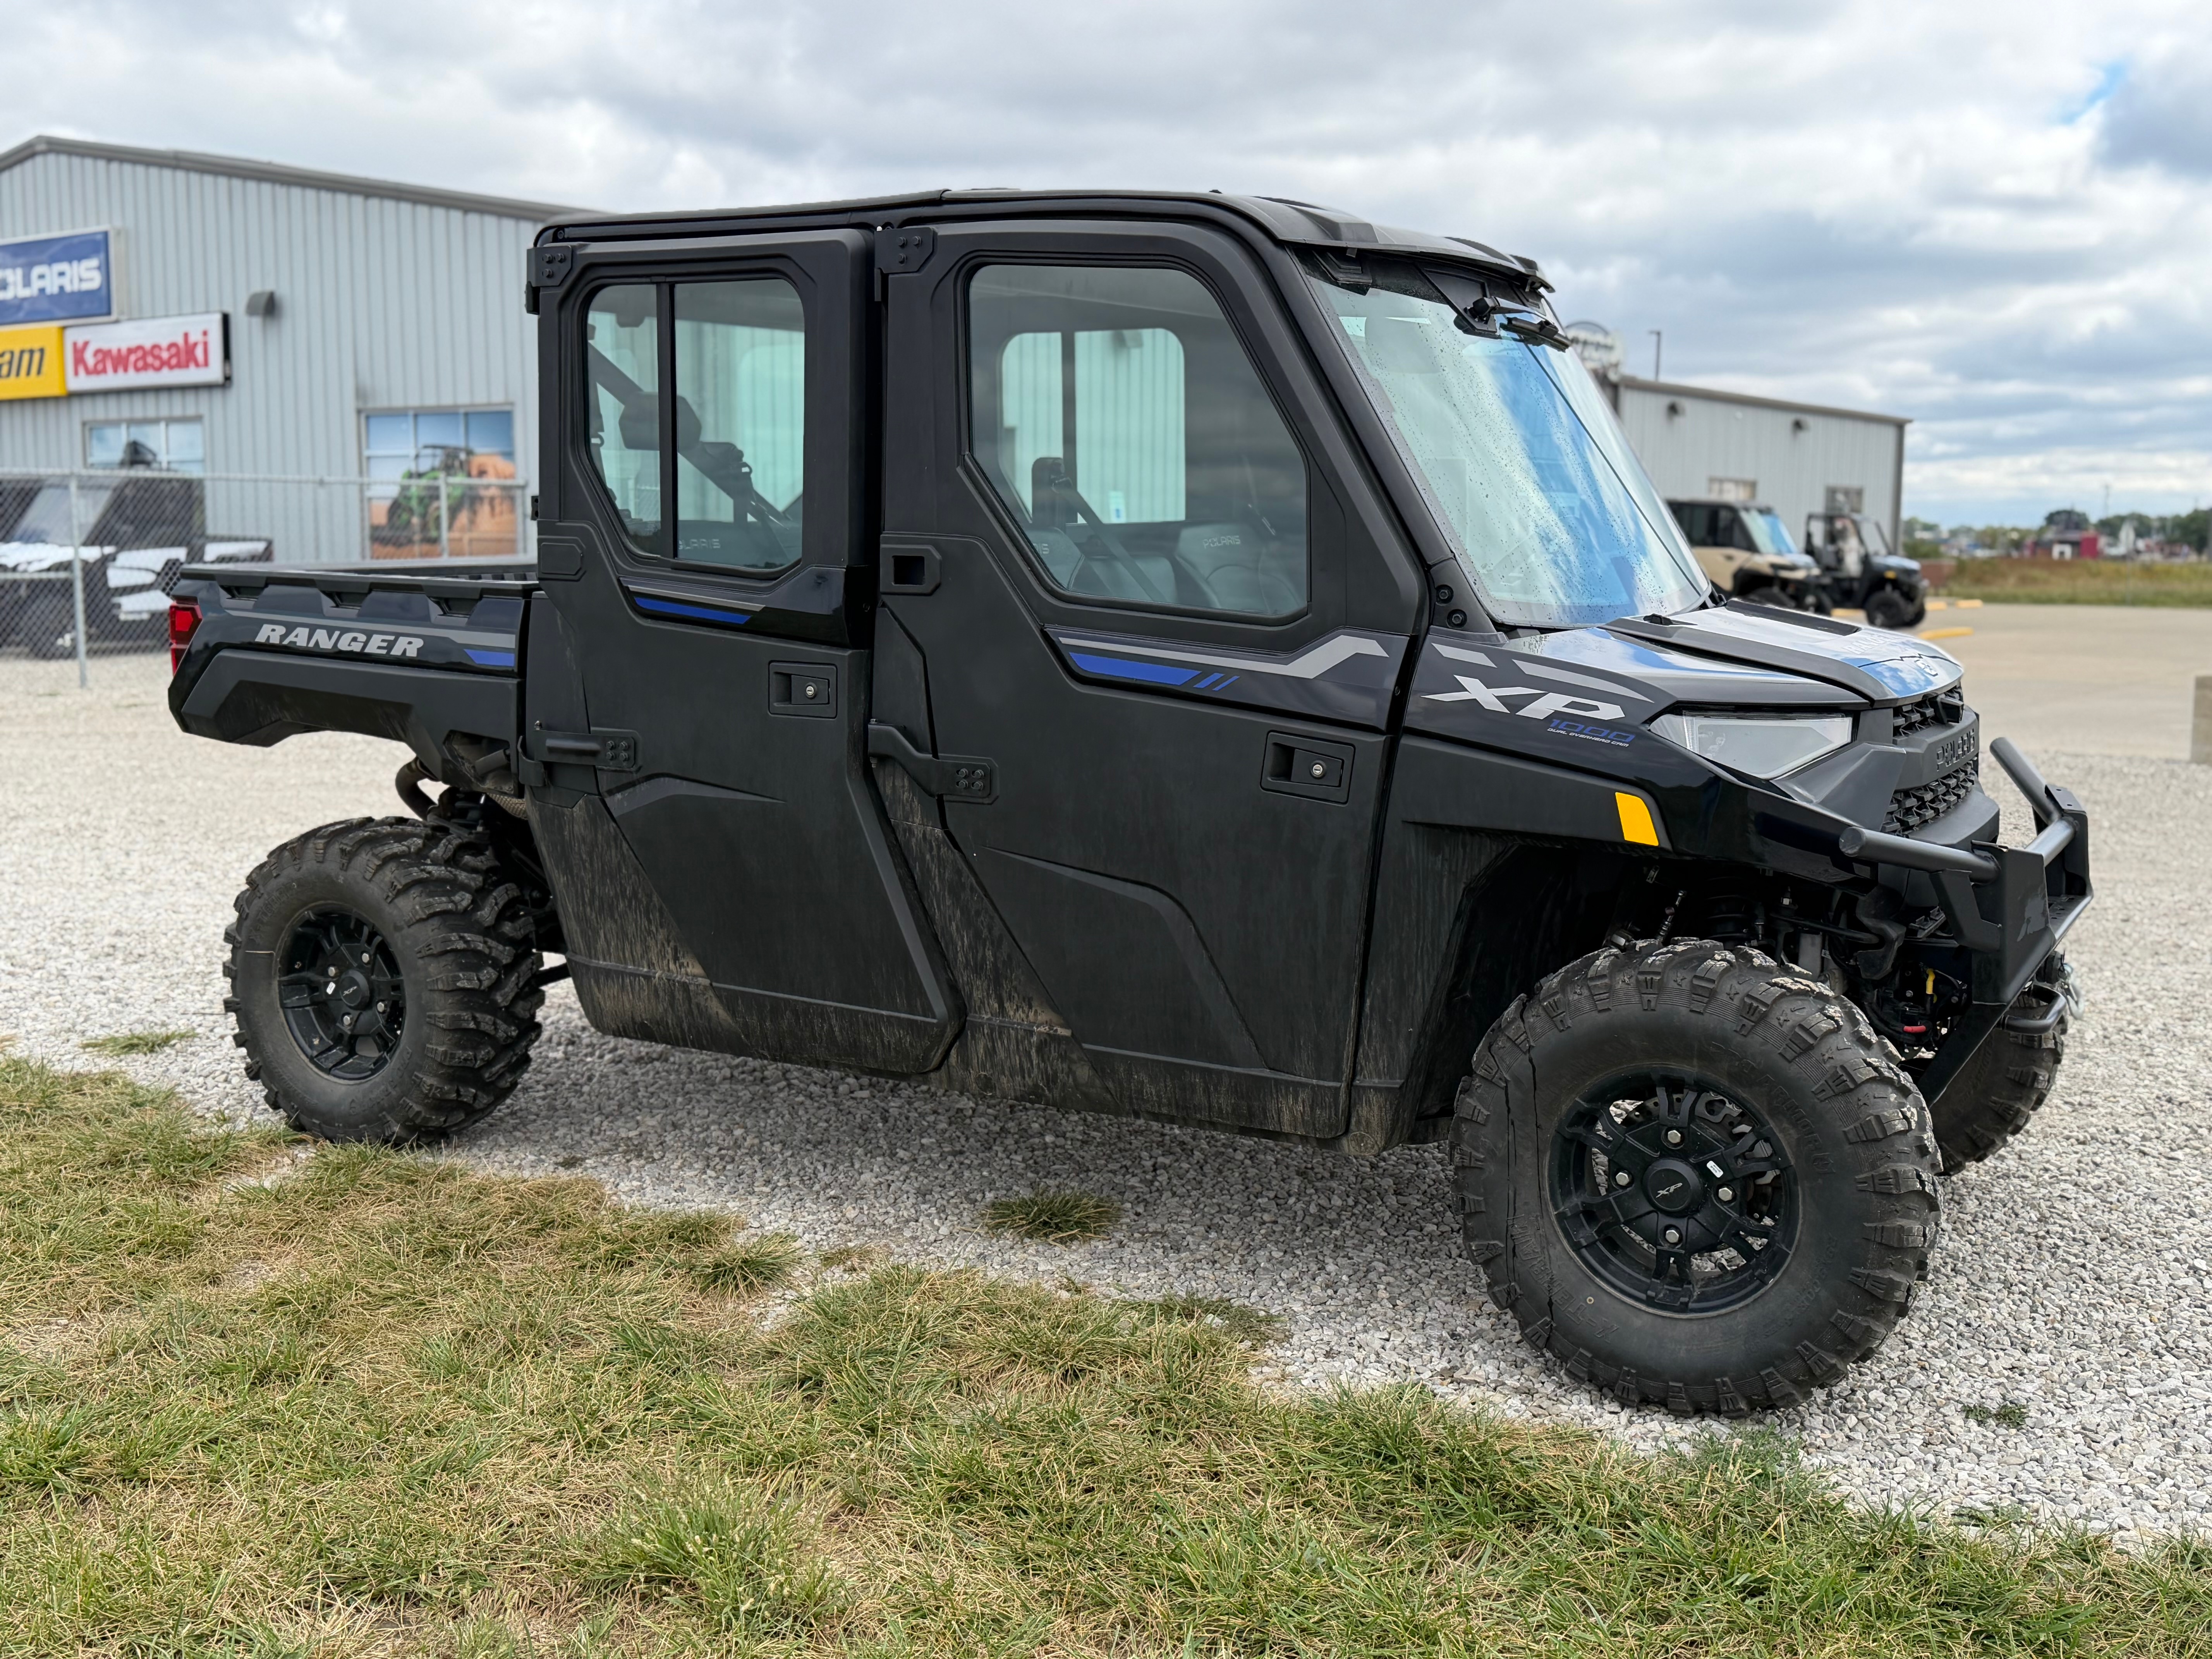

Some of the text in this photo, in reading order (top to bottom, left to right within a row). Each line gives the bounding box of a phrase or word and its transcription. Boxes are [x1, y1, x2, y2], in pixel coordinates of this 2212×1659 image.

[0, 347, 45, 378] am
[73, 330, 209, 376] Kawasaki
[1202, 535, 1241, 550] POLARIS
[255, 624, 424, 657] RANGER
[1420, 675, 1625, 720] XP
[1549, 719, 1635, 742] 1000
[1569, 732, 1611, 743] OVERHEAD
[343, 986, 357, 996] XP
[1656, 1183, 1683, 1198] XP
